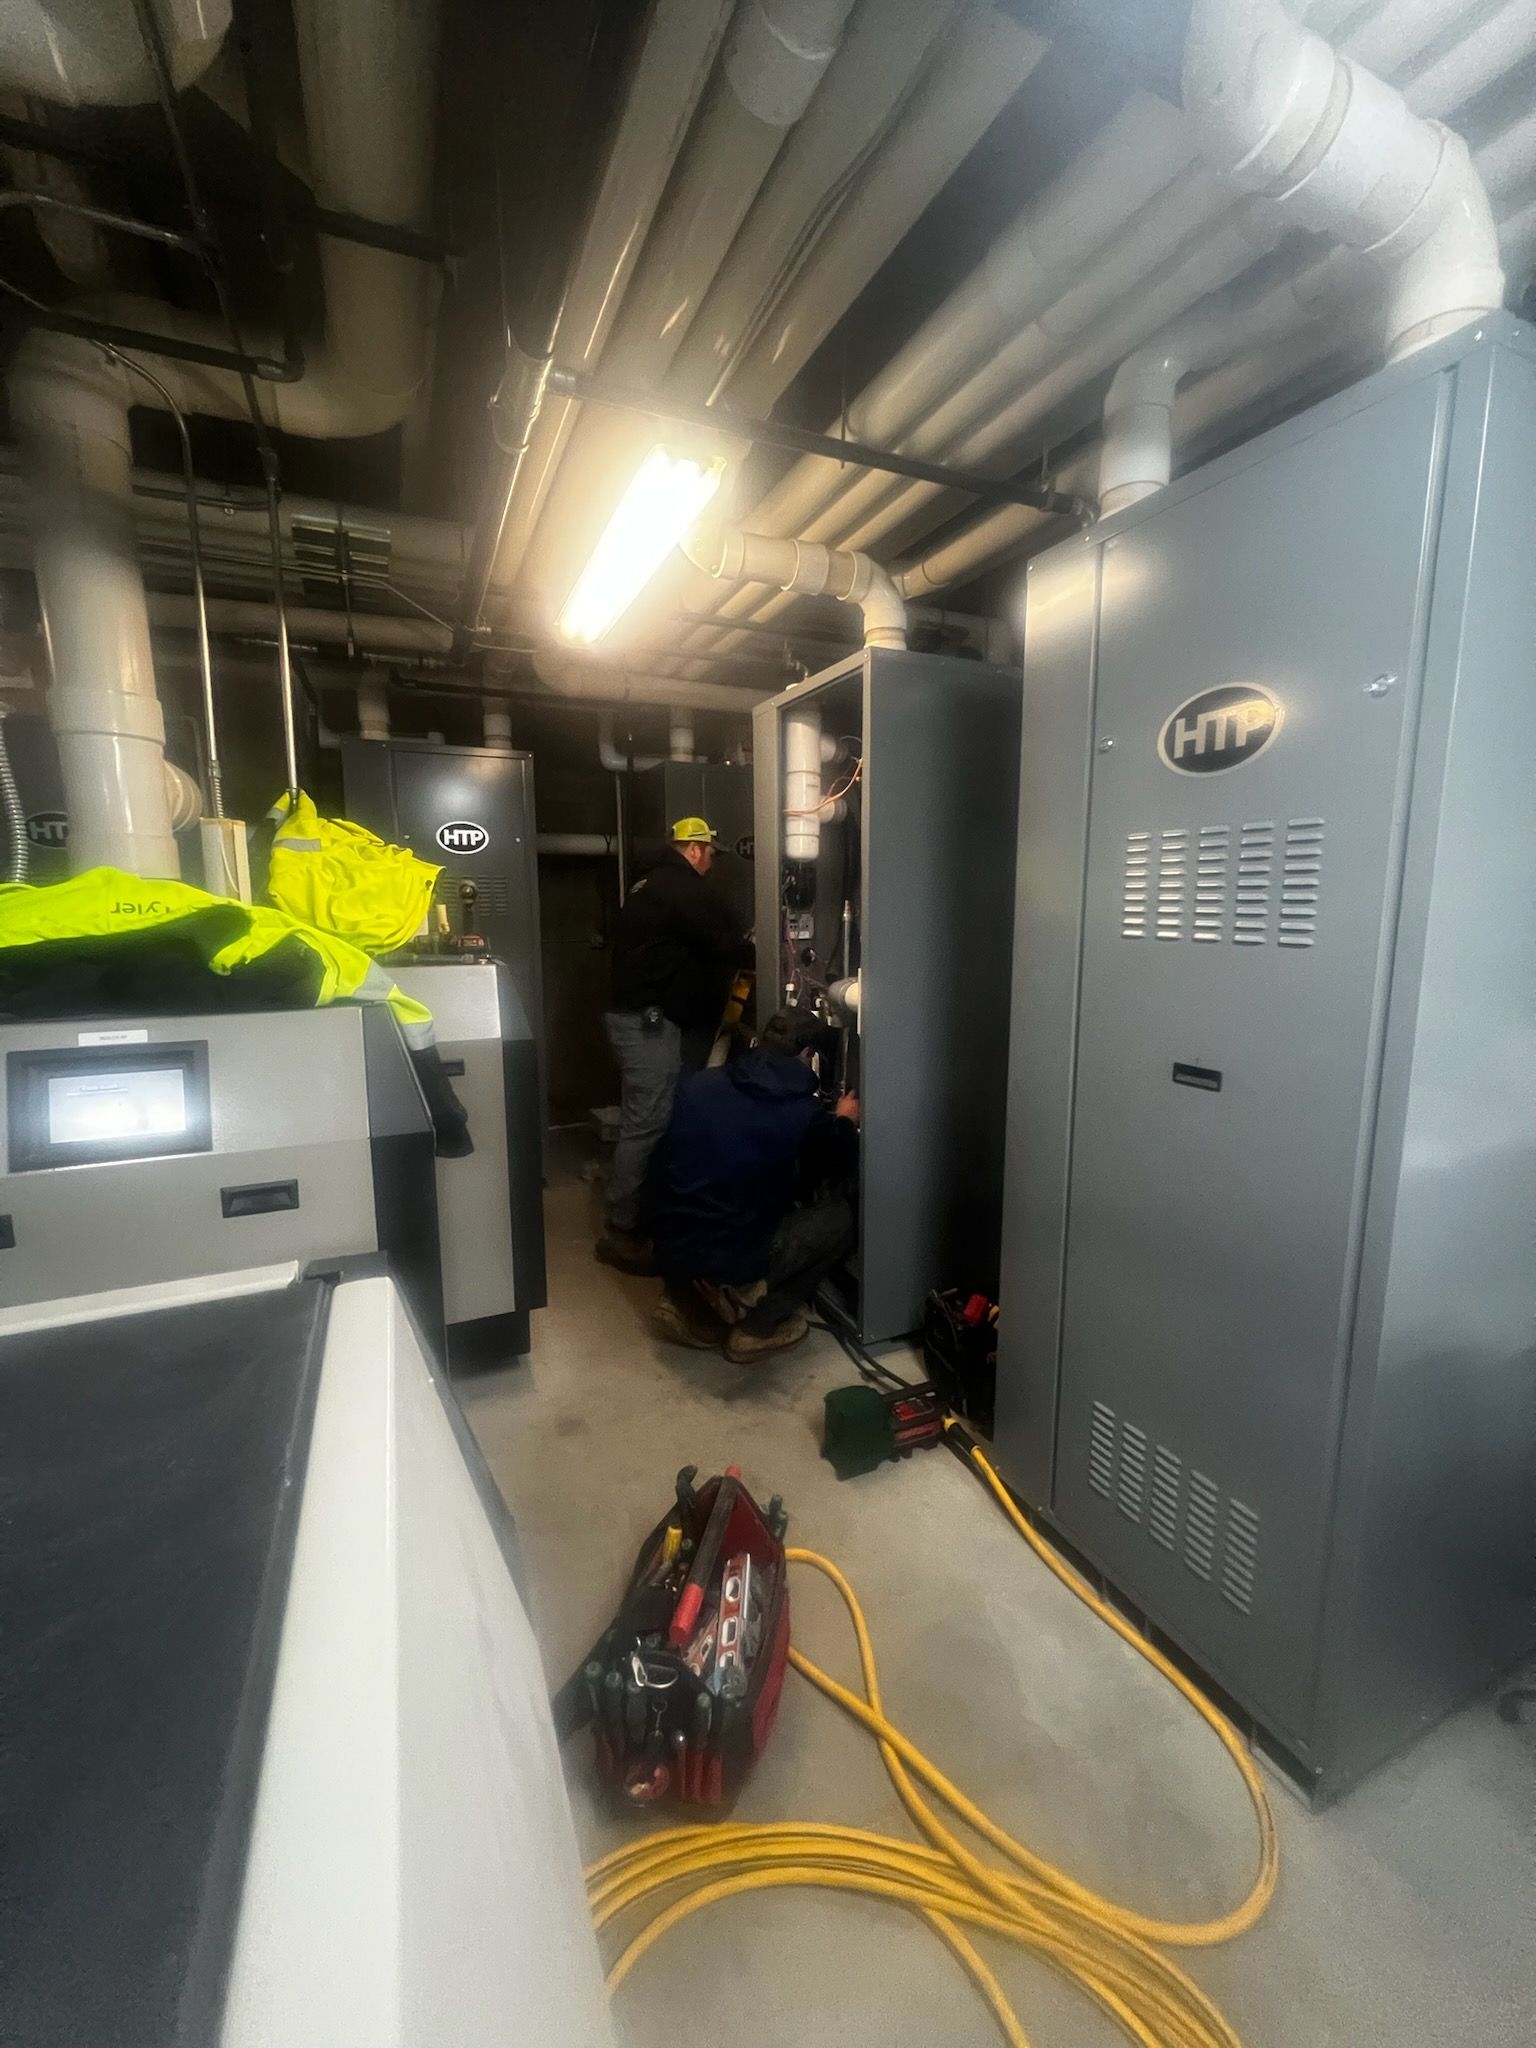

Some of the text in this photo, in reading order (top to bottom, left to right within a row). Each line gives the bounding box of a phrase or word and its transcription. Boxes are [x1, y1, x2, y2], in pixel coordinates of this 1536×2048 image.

[1173, 699, 1275, 759] HTP
[29, 821, 69, 840] HT
[443, 829, 484, 846] HTP
